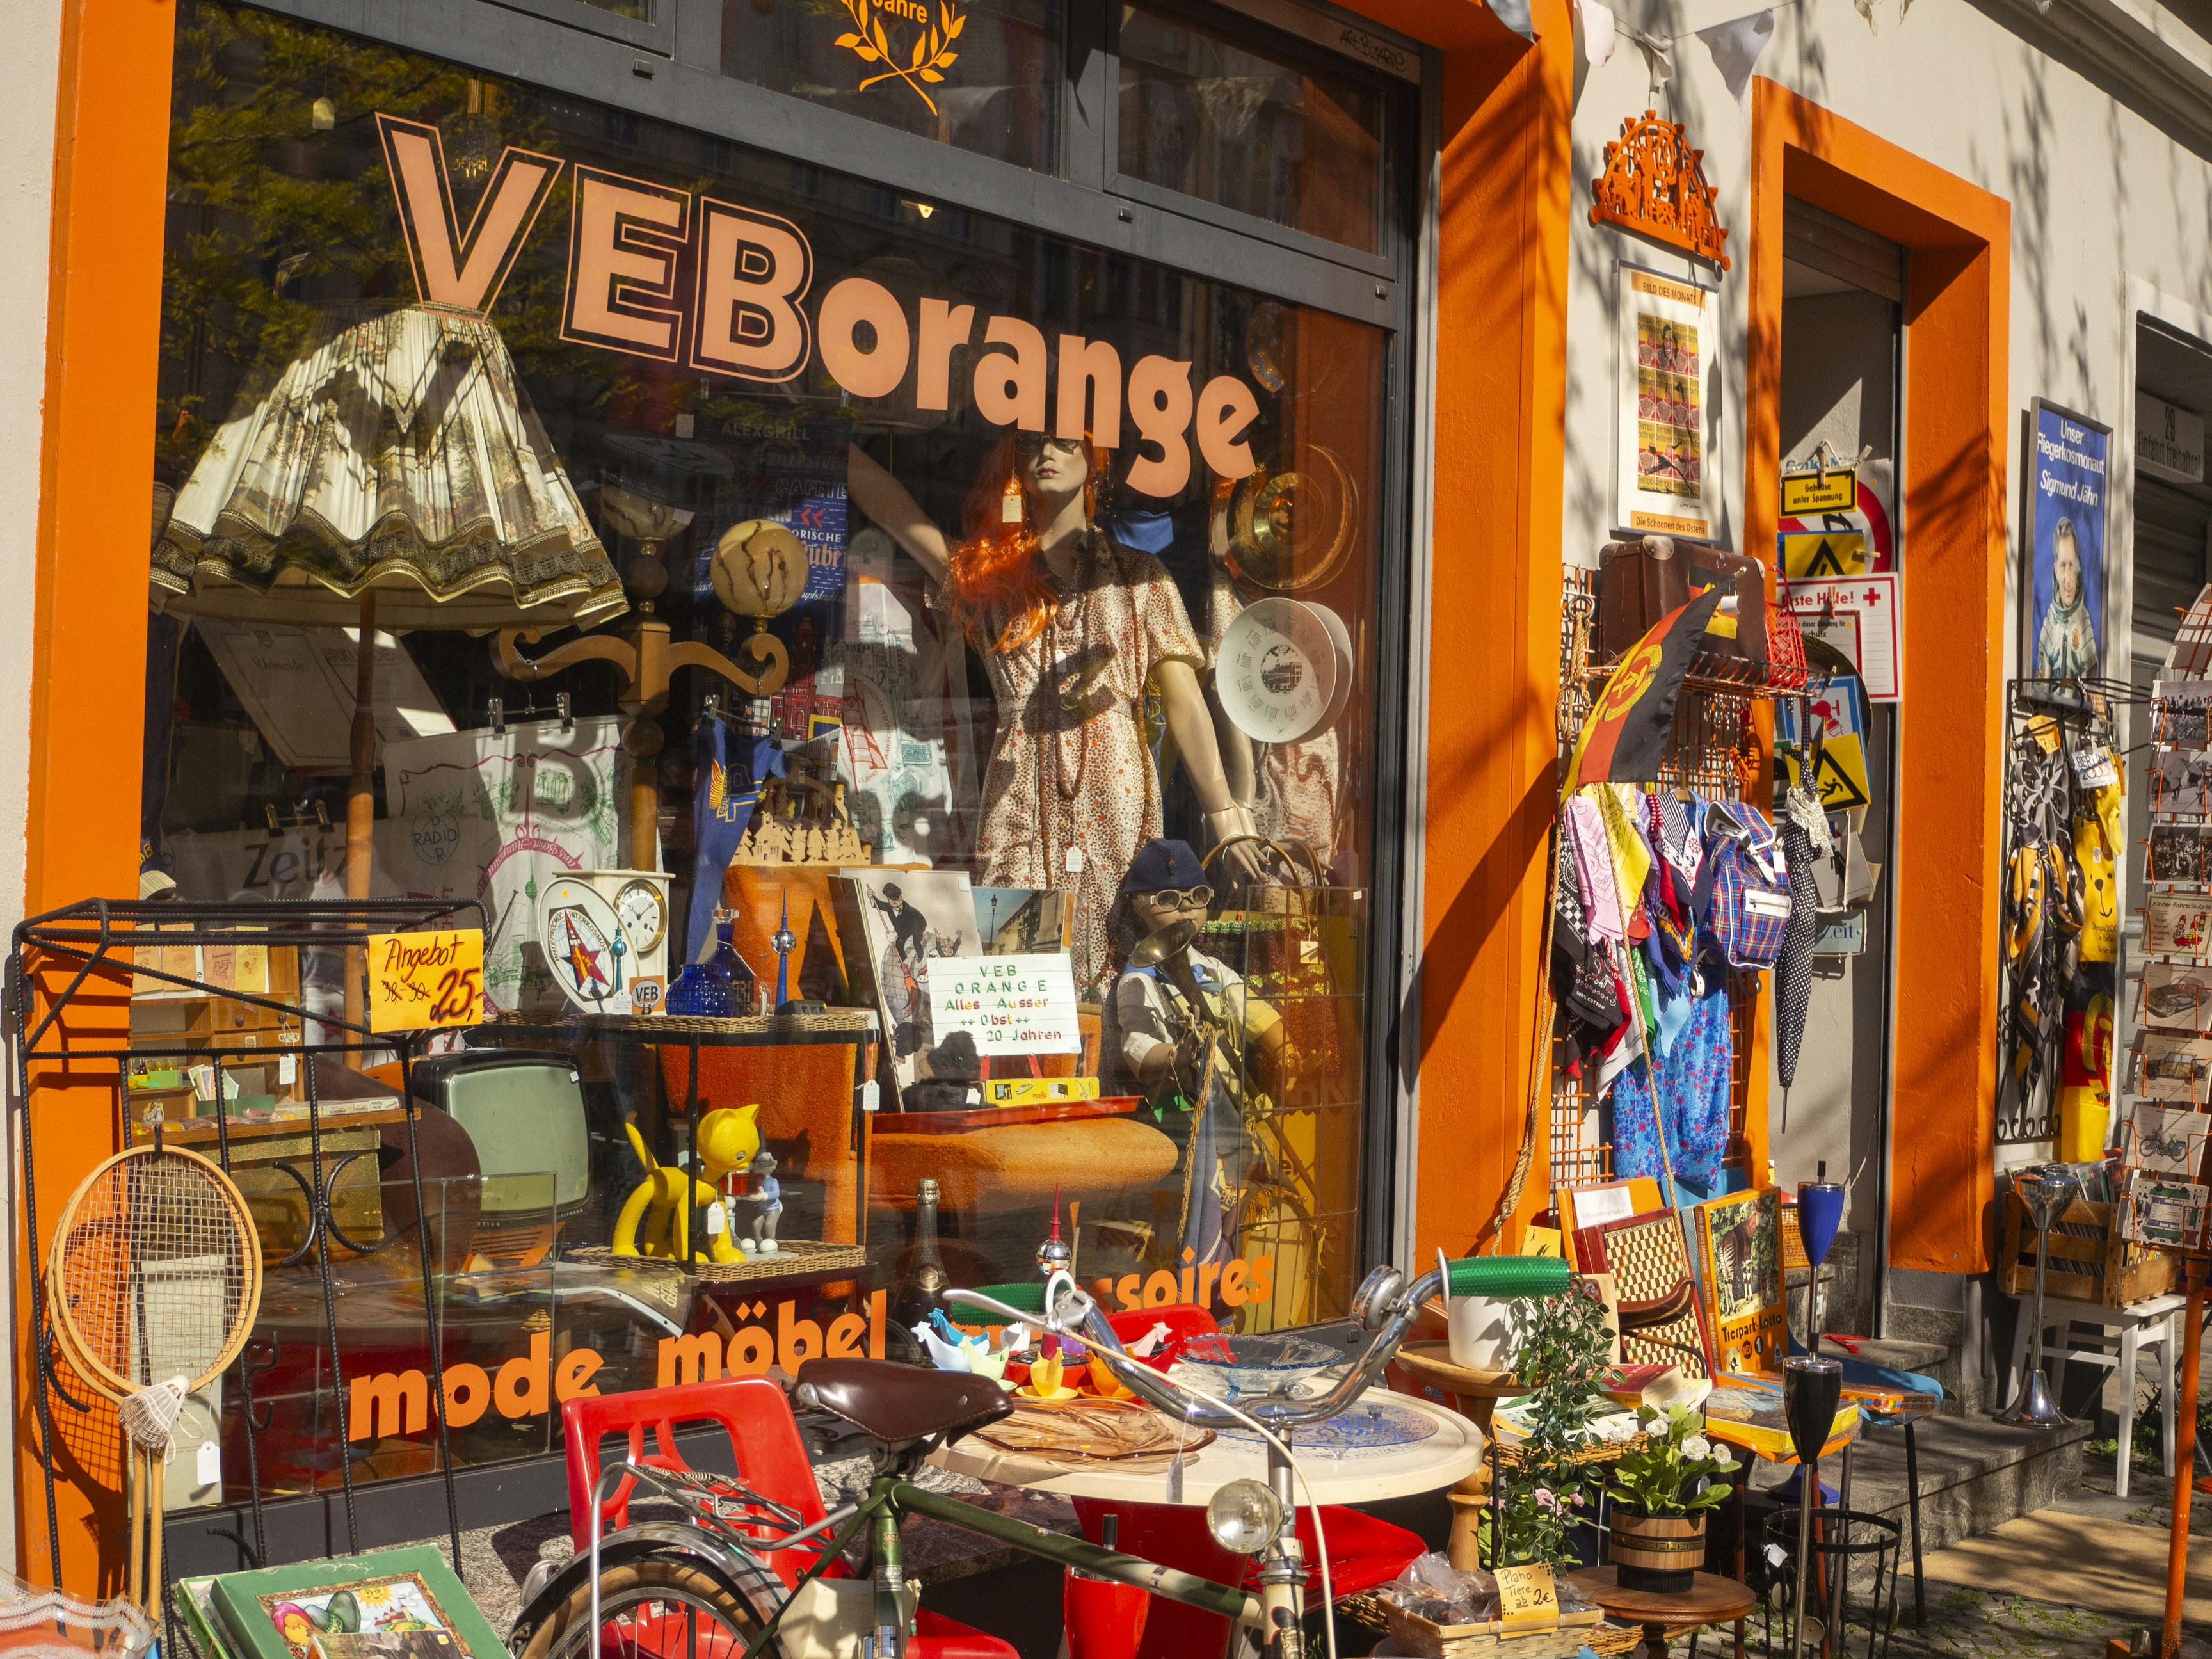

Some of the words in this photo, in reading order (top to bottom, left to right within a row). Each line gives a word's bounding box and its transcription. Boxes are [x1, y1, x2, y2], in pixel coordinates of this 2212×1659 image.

[1643, 282, 1657, 294] BILD
[1659, 286, 1670, 298] DES
[1671, 290, 1696, 304] MONATS
[721, 422, 811, 441] ALEXGRILL
[2060, 419, 2083, 445] Unser
[2165, 406, 2176, 443] 29
[2037, 431, 2104, 475] Fliegerkosmonaut
[2138, 431, 2165, 465] Einfahrt
[2166, 442, 2200, 476] freihalten!
[2040, 469, 2078, 500] Sigmund
[2077, 485, 2098, 507] Jähn
[1793, 496, 1809, 504] unter
[1812, 493, 1843, 503] Spannung
[1636, 517, 1646, 526] Die
[1647, 518, 1674, 530] Schoenen
[1676, 522, 1685, 532] des
[1687, 523, 1705, 534] Ostens
[414, 828, 458, 846] RADIO
[569, 911, 607, 952] INTERKOSMOS
[385, 934, 464, 983] Angebot
[980, 965, 1016, 977] VEB
[636, 986, 658, 1002] VEB
[1576, 991, 1587, 1000] 100%
[1587, 997, 1605, 1011] COTTON
[945, 999, 981, 1011] Alles
[997, 997, 1048, 1009] Ausser
[981, 1014, 1013, 1025] Obst
[986, 1030, 1003, 1042] 20
[1012, 1029, 1062, 1041] Jahren
[1721, 1312, 1783, 1342] Tierpark-Lotto
[1743, 1343, 1752, 1356] NEU
[349, 1331, 604, 1443] mode
[657, 1289, 886, 1388] möbel
[1504, 1585, 1531, 1597] Tiere
[1516, 1596, 1527, 1607] ab
[1533, 1589, 1555, 1605] 2€
